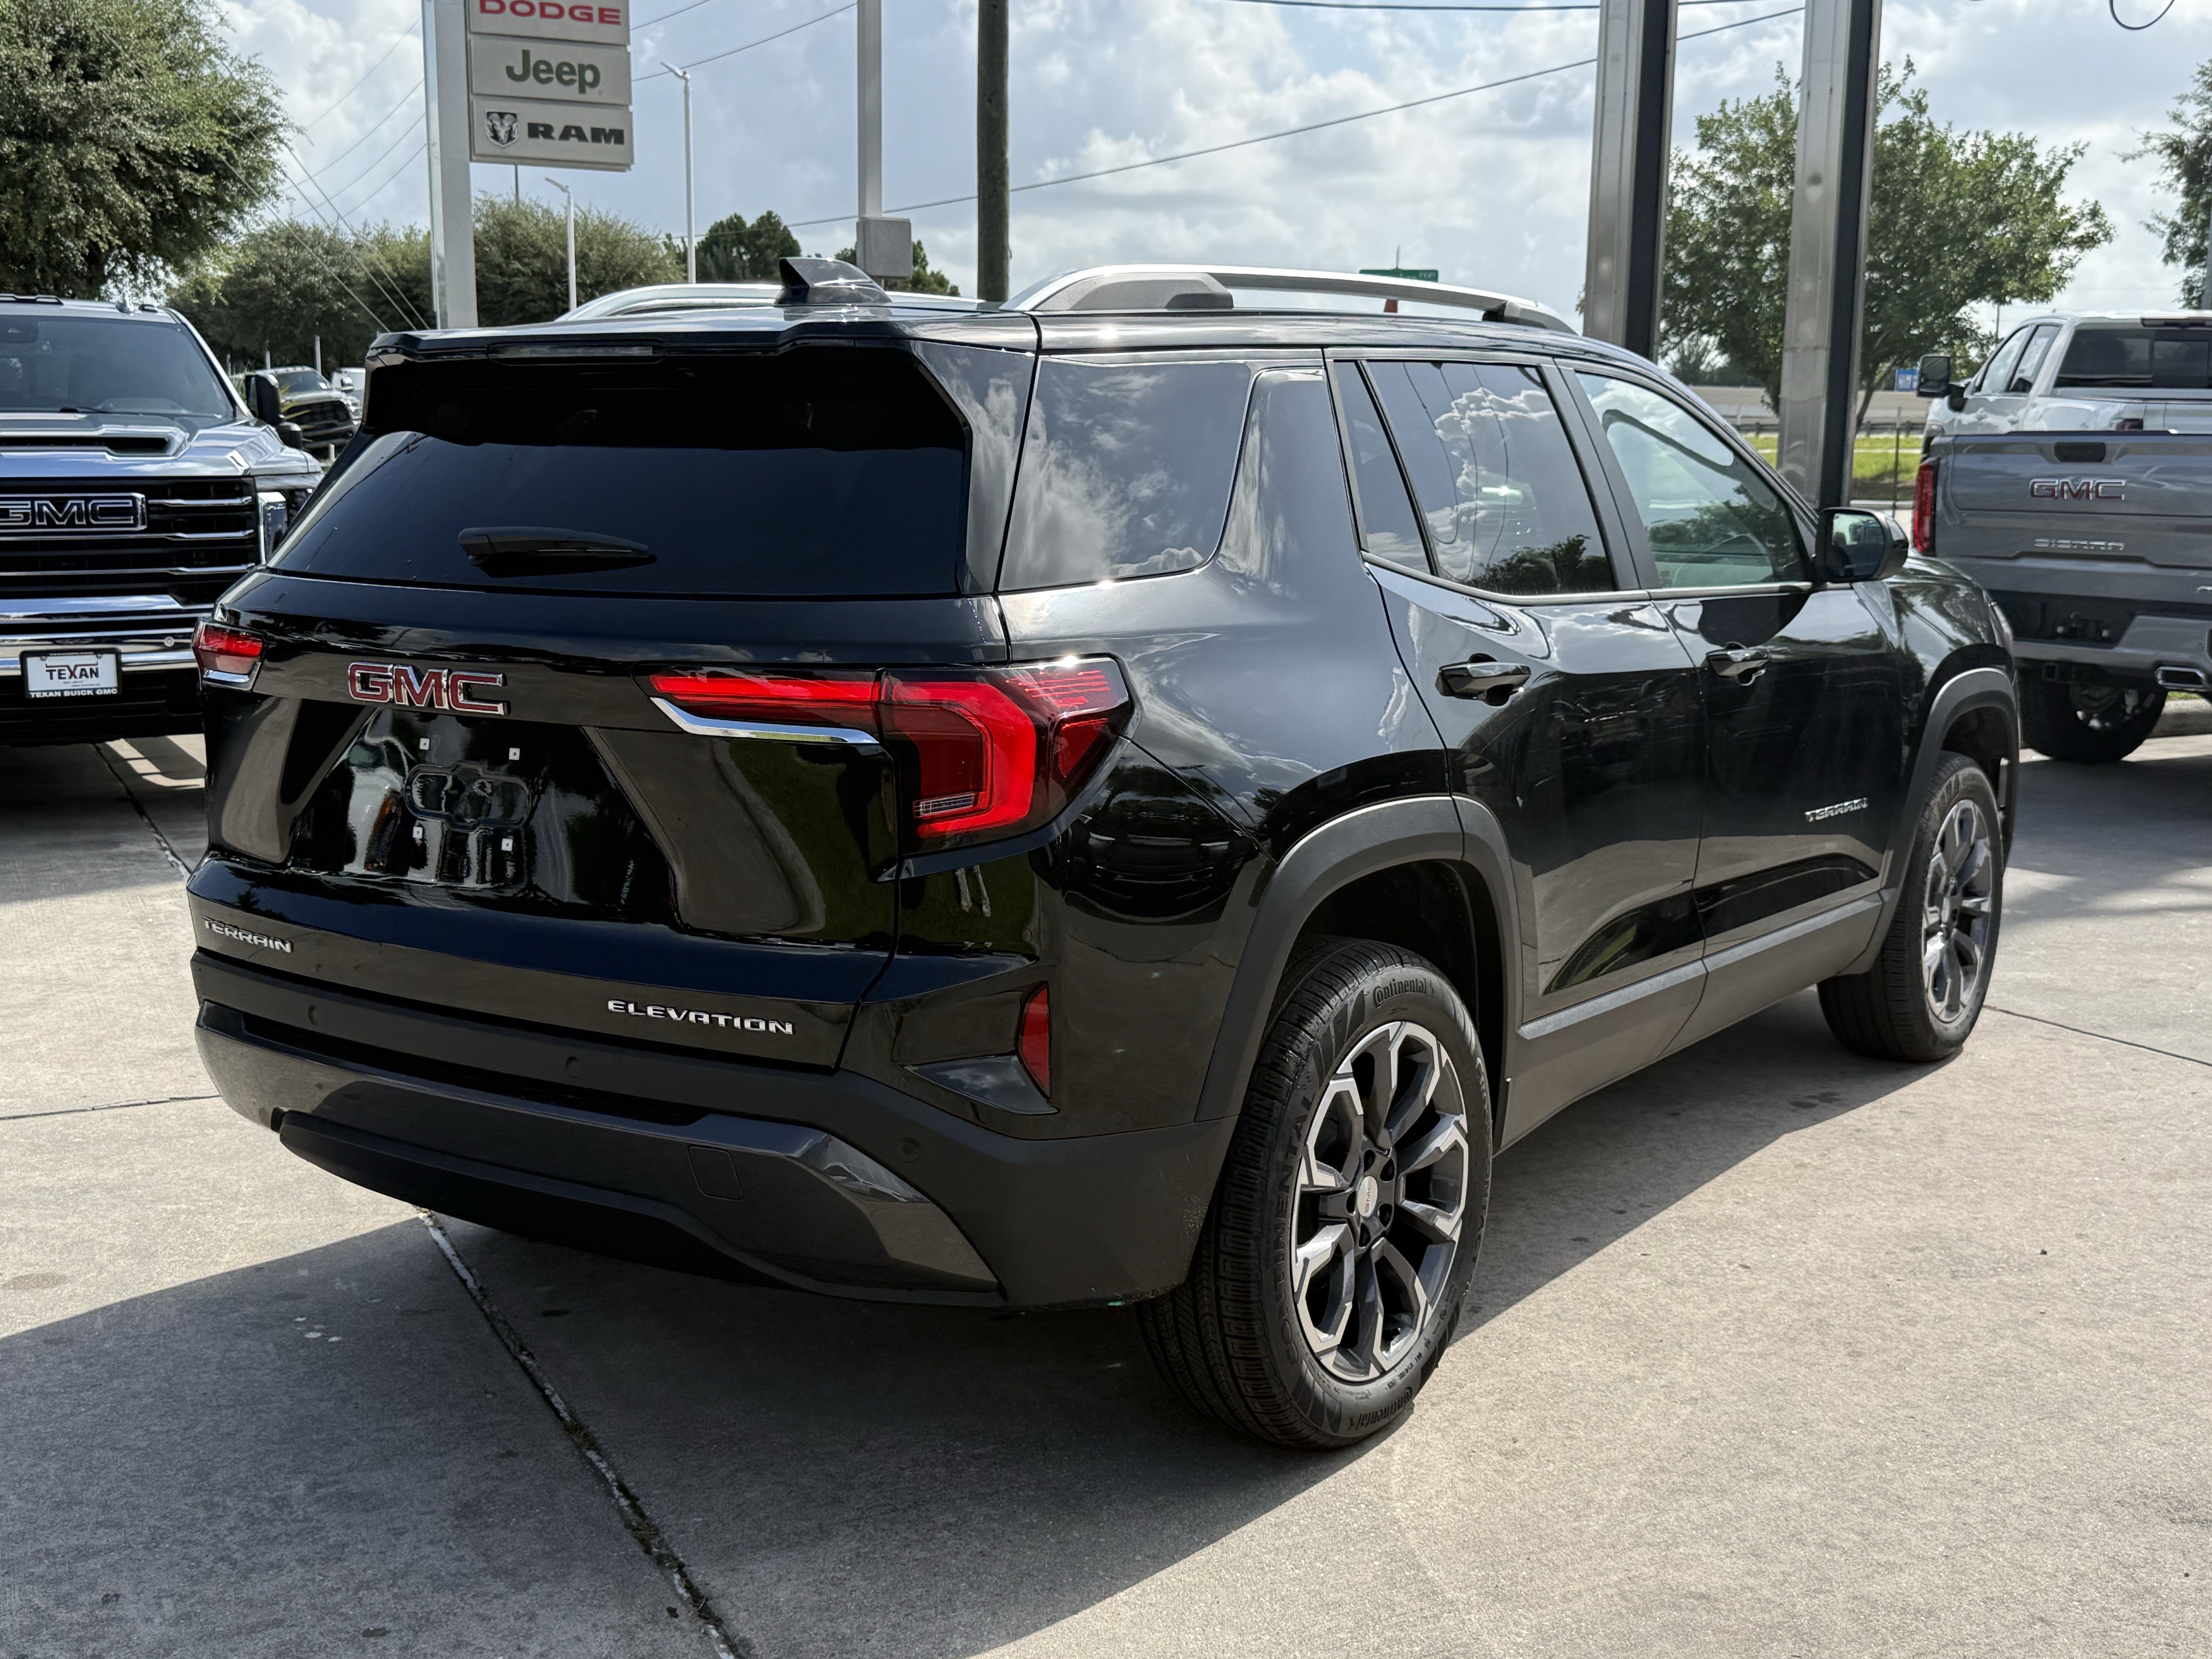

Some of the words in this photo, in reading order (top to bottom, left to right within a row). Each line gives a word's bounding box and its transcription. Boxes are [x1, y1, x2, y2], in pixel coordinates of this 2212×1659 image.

[479, 0, 621, 25] DODGE
[506, 49, 601, 94] Jeep
[528, 122, 625, 145] RAM
[2030, 478, 2126, 500] GMC
[0, 498, 134, 526] GMC
[45, 664, 100, 680] TEXAN
[349, 661, 505, 715] GMC
[201, 915, 293, 953] TERRAIN
[1373, 977, 1427, 1008] Continental
[608, 1000, 793, 1035] ELEVATION
